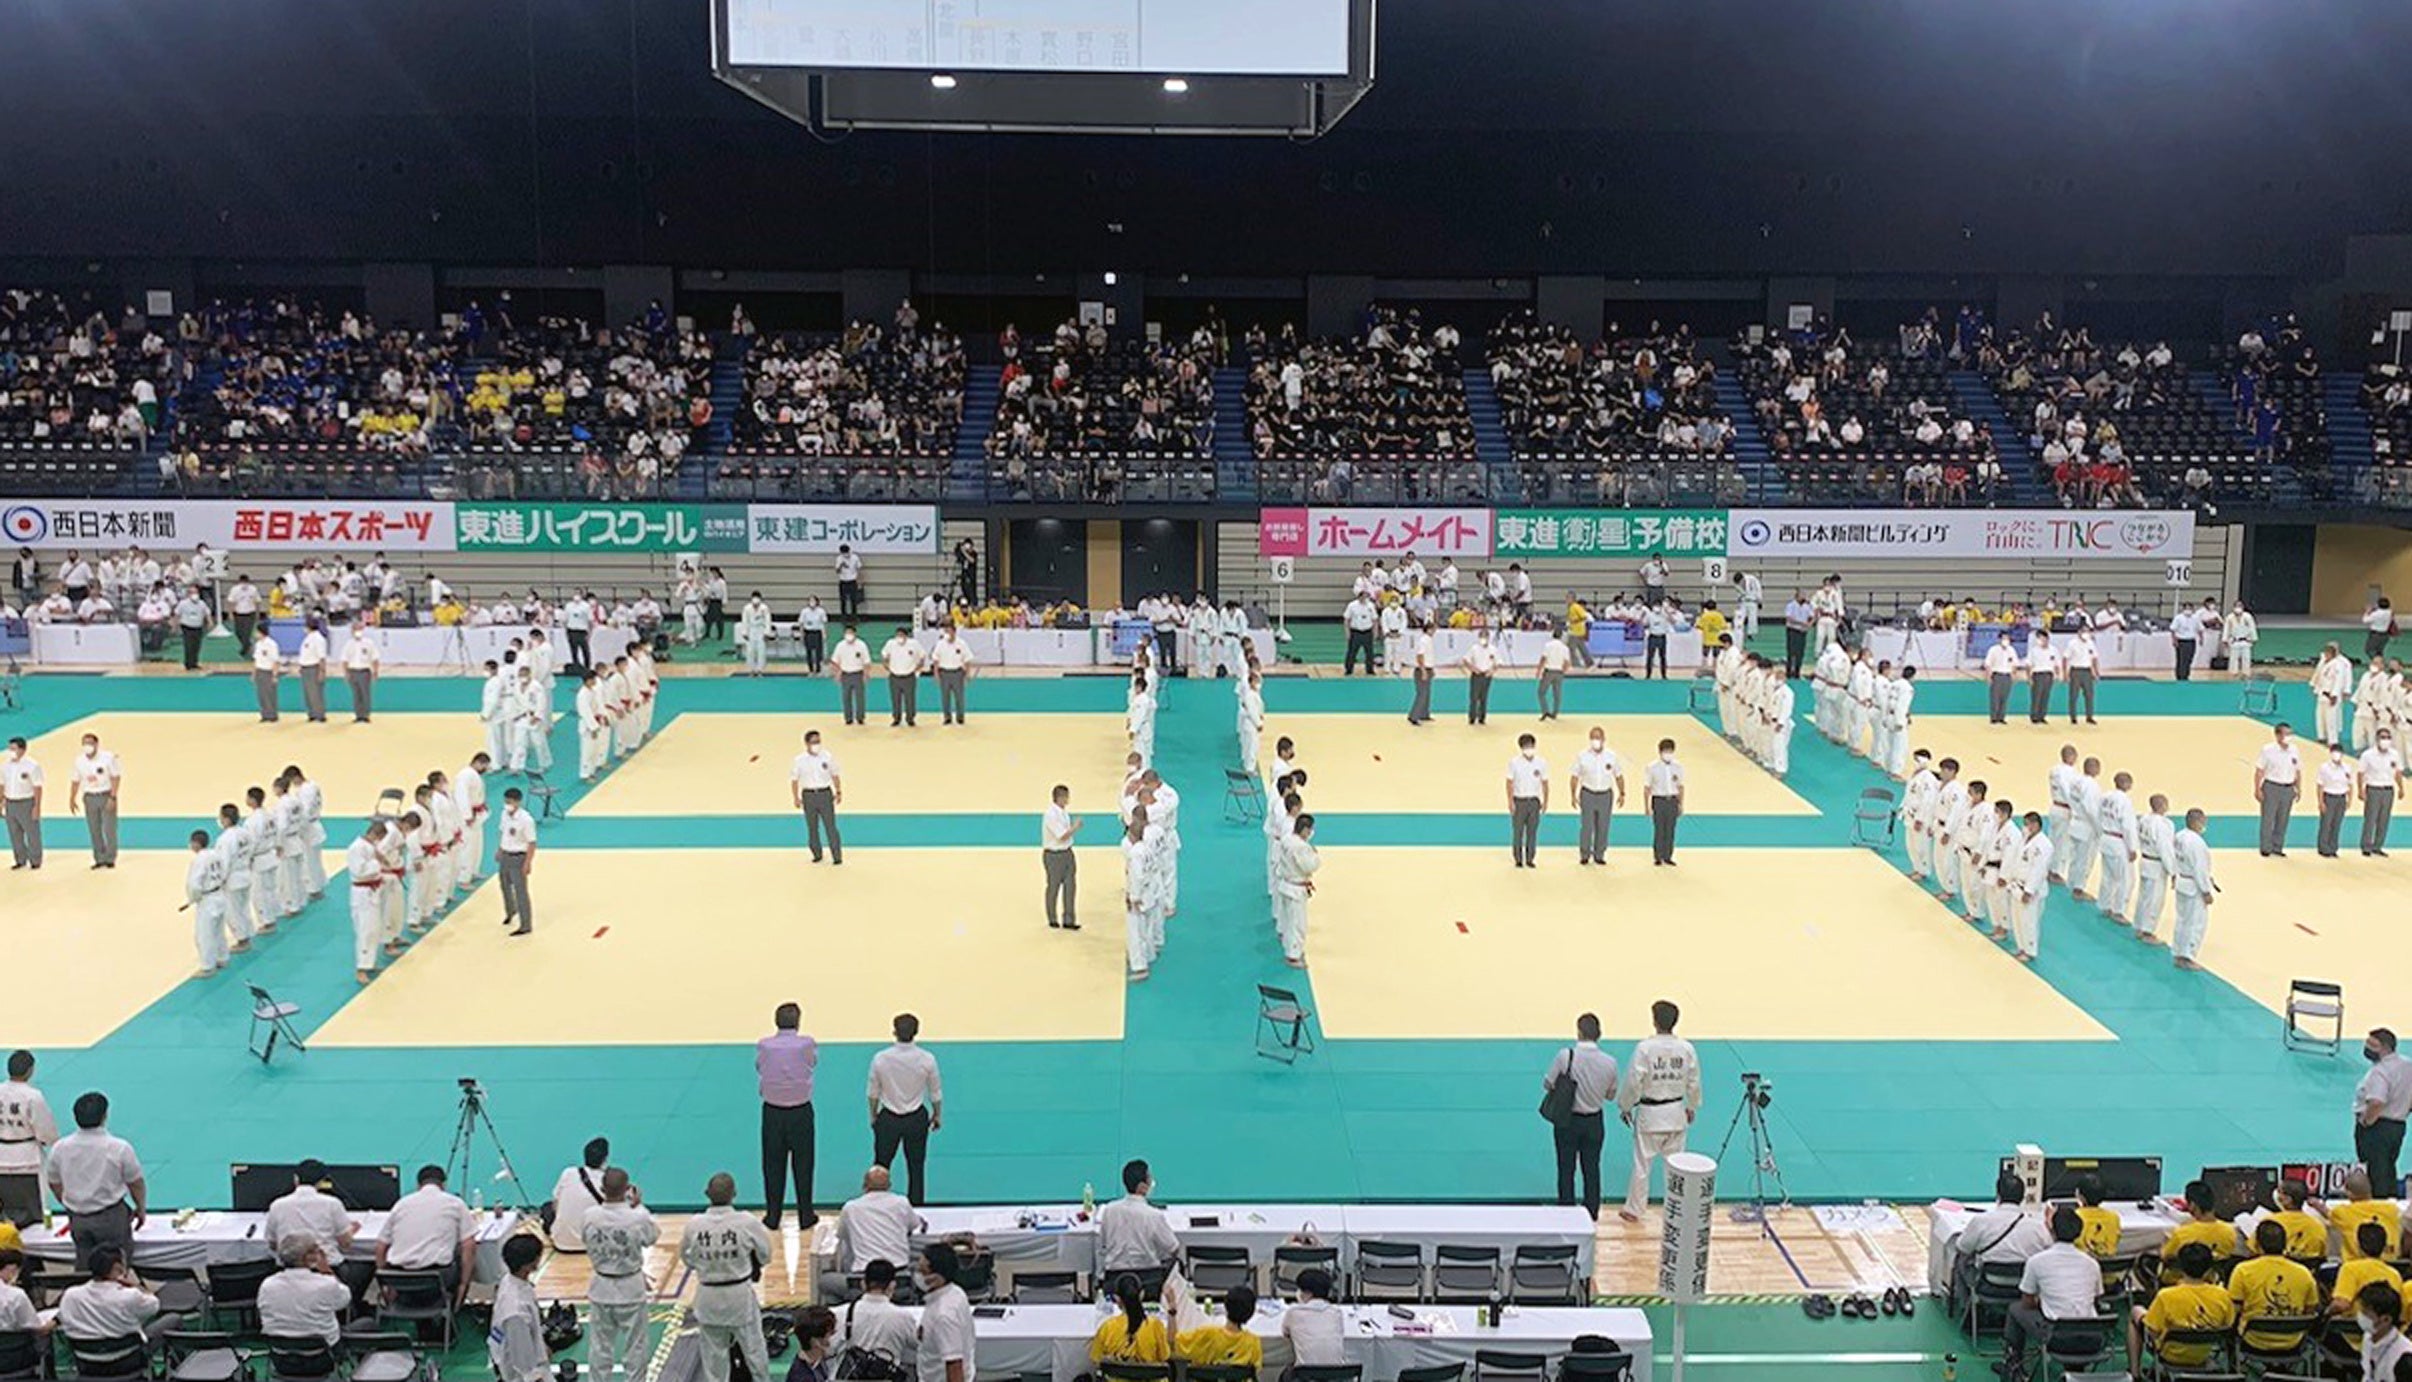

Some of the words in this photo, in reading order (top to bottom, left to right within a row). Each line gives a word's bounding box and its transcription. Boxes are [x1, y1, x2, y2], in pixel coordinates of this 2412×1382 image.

[52, 510, 176, 539] 西日本新聞
[233, 509, 433, 541] 西日本スポーツ
[458, 507, 697, 545] 東進ハイスクール
[755, 516, 930, 542] 東建コーポレーション
[1317, 514, 1477, 548] ホームメイト
[1497, 516, 1725, 551] 東進衛星予備校
[1779, 523, 1949, 543] 西日本新聞ビルディング
[2047, 520, 2114, 549] TNC
[1277, 562, 1289, 578] 6
[1711, 563, 1722, 579] 8
